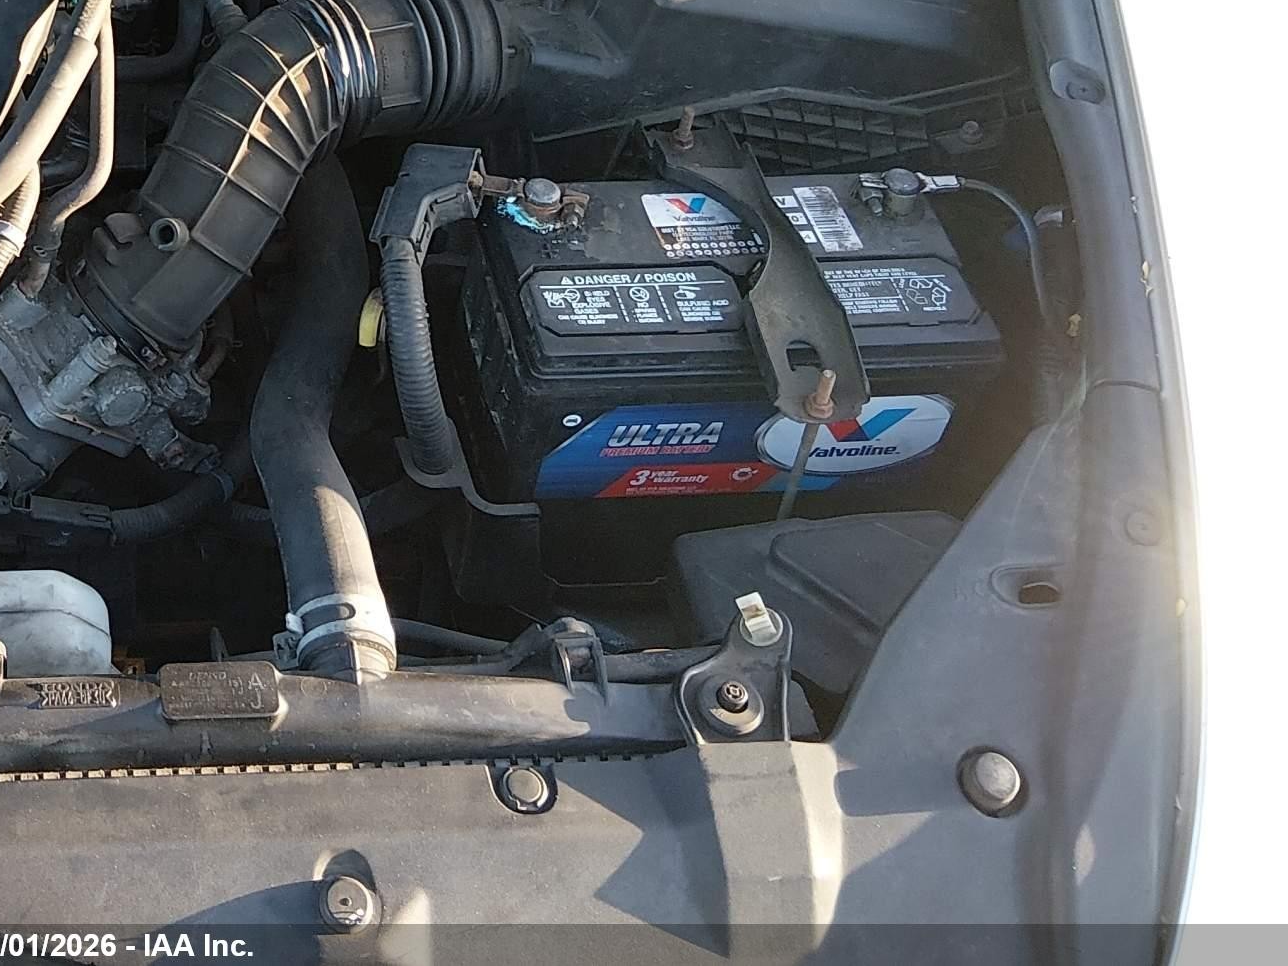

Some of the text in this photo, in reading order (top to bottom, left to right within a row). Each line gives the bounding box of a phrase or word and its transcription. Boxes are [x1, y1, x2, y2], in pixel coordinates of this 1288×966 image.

[575, 274, 631, 284] DANGER
[645, 272, 697, 283] POISON
[607, 421, 725, 448] ULTRA
[599, 443, 717, 457] PREMIUM BATTERY
[629, 469, 680, 486] 3 year
[652, 474, 709, 484] warranty
